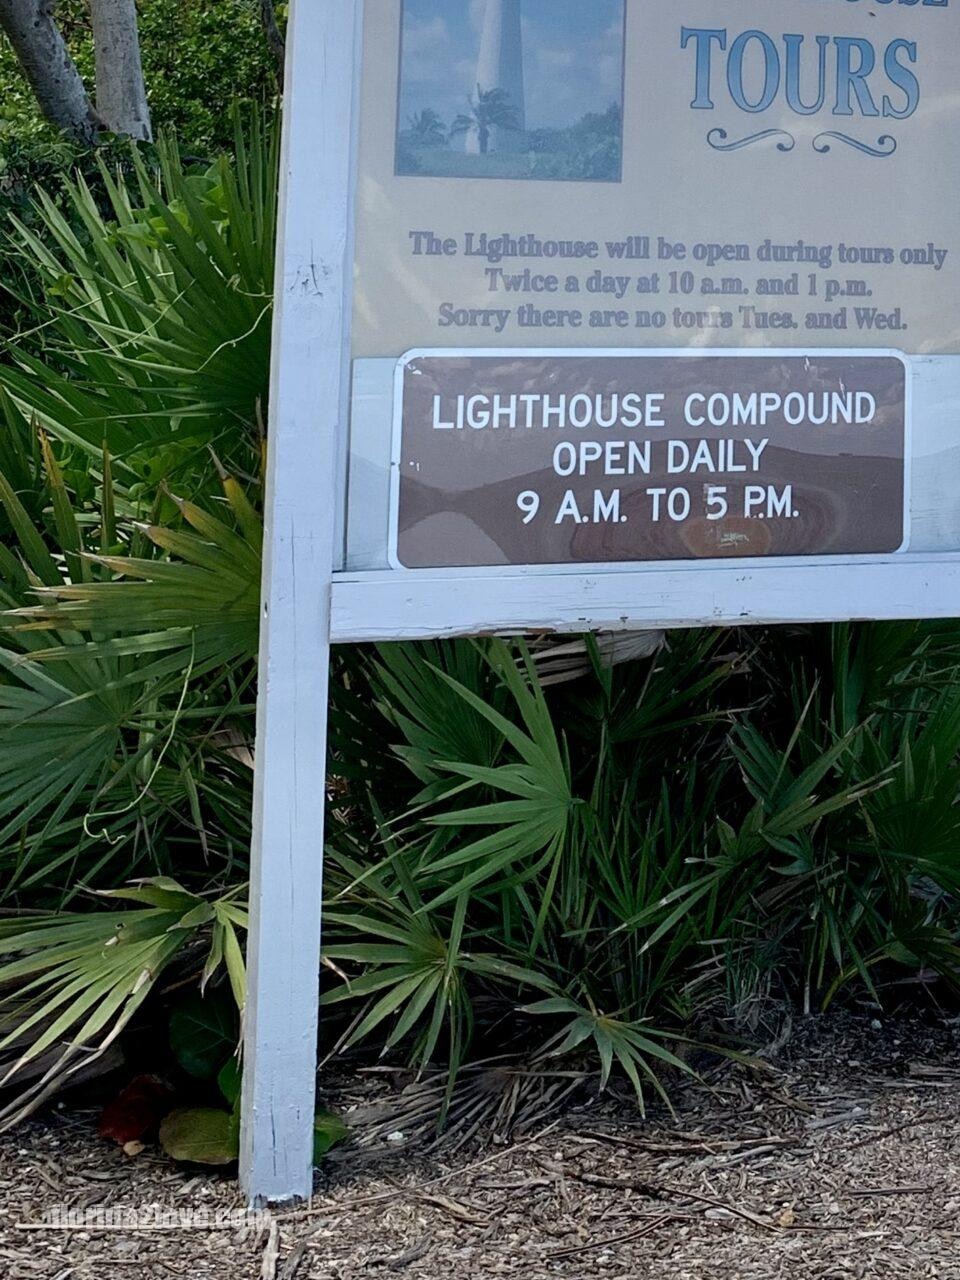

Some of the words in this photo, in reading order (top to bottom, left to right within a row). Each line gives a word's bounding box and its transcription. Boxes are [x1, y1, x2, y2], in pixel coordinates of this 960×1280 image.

[680, 26, 920, 120] TOURS
[408, 231, 457, 256] The
[463, 232, 599, 263] Lighthouse
[605, 236, 650, 260] will
[657, 237, 686, 260] be
[692, 243, 750, 267] open
[756, 239, 832, 269] during
[837, 243, 895, 264] tours
[899, 243, 948, 271] only
[484, 267, 559, 293] Twice
[564, 275, 580, 293] a
[585, 270, 631, 299] day
[636, 272, 660, 294] at
[668, 271, 695, 295] 10
[701, 276, 749, 296] a.m.
[755, 273, 800, 296] and
[807, 274, 817, 296] 1
[824, 278, 873, 302] p.m.
[438, 302, 511, 333] Sorry
[516, 304, 583, 328] there
[588, 310, 629, 328] are
[635, 310, 666, 328] no
[672, 306, 733, 329] tours
[738, 306, 798, 329] Tues.
[804, 307, 848, 330] and
[852, 307, 908, 331] Wed.
[432, 393, 665, 429] LIGHTHOUSE
[683, 391, 877, 426] COMPOUND
[552, 440, 651, 476] OPEN
[667, 438, 769, 474] DAILY
[516, 490, 540, 525] 9
[554, 489, 628, 524] A.M.
[646, 487, 691, 522] TO
[705, 486, 728, 520] 5
[744, 484, 800, 519] P.M.
